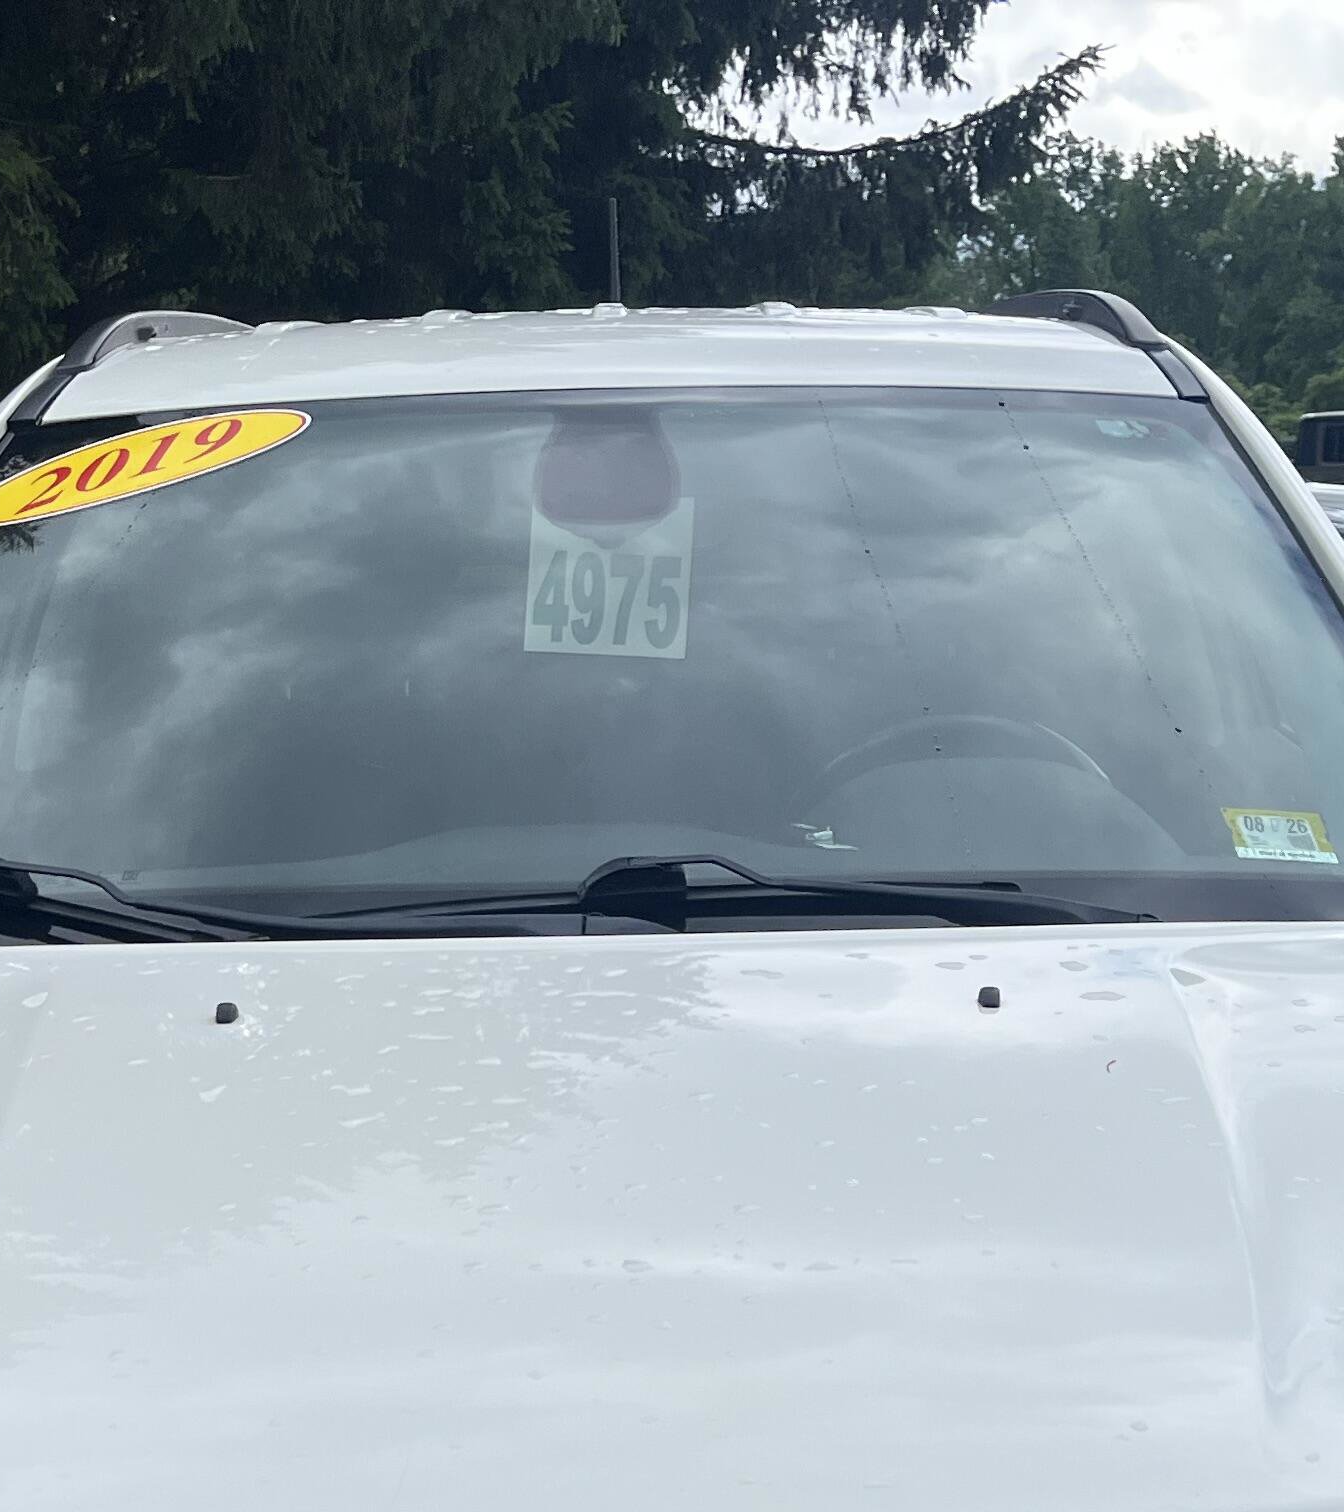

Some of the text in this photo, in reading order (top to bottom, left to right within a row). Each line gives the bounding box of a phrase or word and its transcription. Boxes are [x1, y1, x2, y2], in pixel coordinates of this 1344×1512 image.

[13, 418, 243, 516] 2019
[532, 550, 683, 650] 4975
[1243, 815, 1309, 834] 08 26
